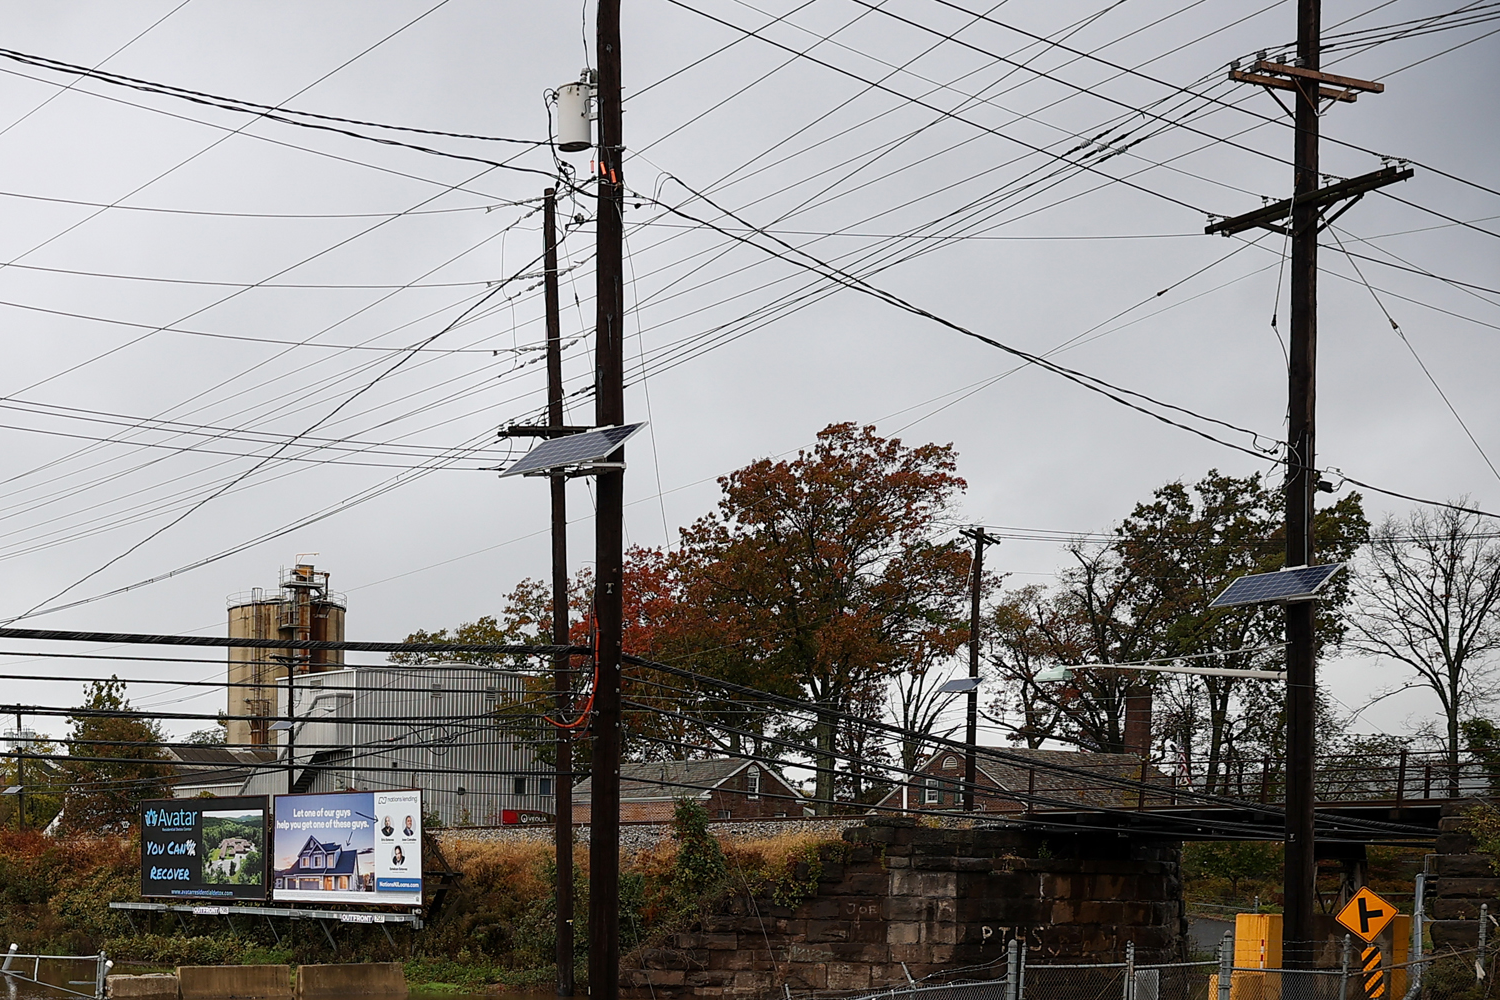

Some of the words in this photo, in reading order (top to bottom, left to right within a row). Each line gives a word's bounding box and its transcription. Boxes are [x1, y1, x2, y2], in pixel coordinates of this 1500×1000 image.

[158, 808, 198, 827] Avatar
[293, 808, 304, 818] Let
[304, 810, 315, 818] one
[315, 808, 324, 818] of
[324, 810, 335, 818] our
[335, 809, 351, 819] guys
[276, 820, 289, 831] help
[290, 822, 302, 831] you
[302, 821, 313, 831] get
[325, 819, 333, 829] of
[333, 819, 351, 829] these
[351, 820, 370, 831] guys.
[150, 866, 190, 881] RECOVER
[341, 914, 373, 922] OUTFRONT
